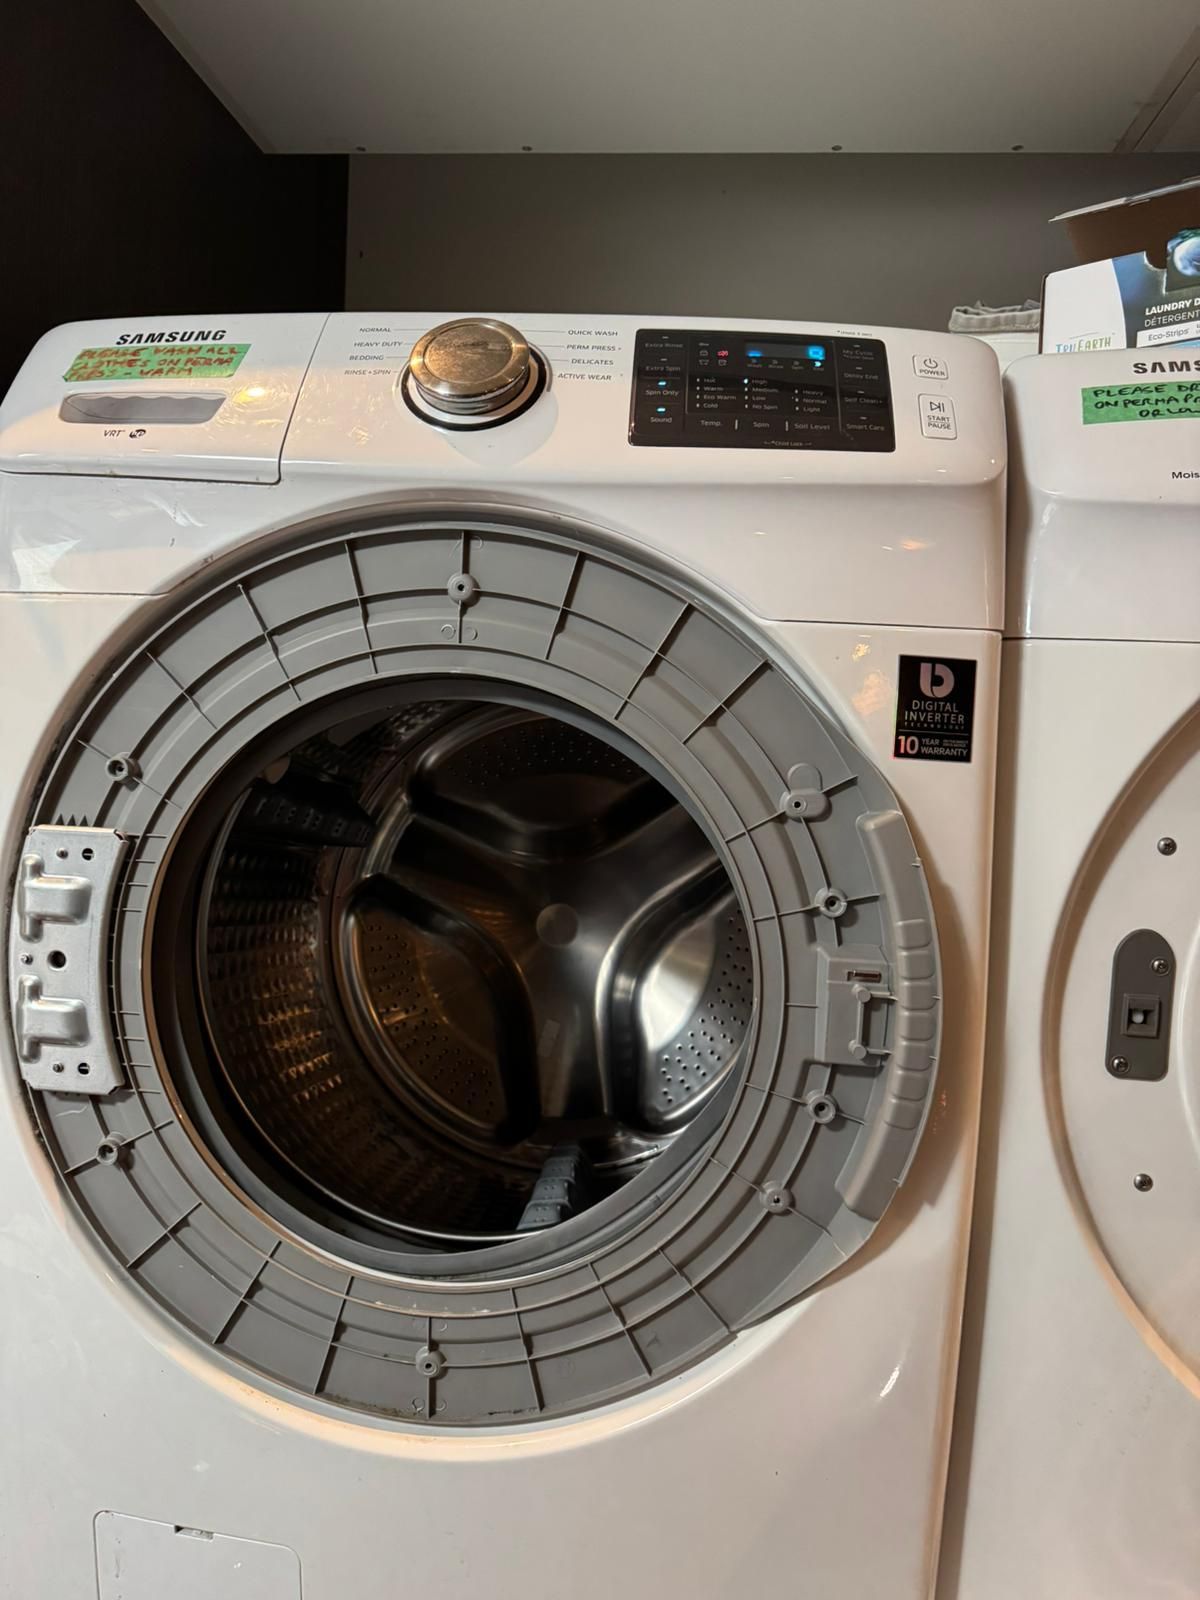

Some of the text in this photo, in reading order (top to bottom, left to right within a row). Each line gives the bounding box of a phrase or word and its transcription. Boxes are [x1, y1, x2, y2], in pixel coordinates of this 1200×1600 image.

[1145, 299, 1193, 316] LAUNDRY
[1144, 309, 1200, 328] DÉTERGENT
[116, 329, 227, 345] SAMSUNG
[1148, 328, 1189, 341] Eco-Strips
[1093, 384, 1168, 397] PLEASE
[1094, 400, 1119, 409] ON
[1122, 396, 1179, 408] PERMA
[927, 414, 950, 422] START
[1139, 409, 1165, 417] OR
[927, 422, 951, 430] PAUSE
[912, 700, 959, 712] DIGITAL
[905, 711, 965, 724] INVERTER
[898, 735, 919, 755] 10
[921, 746, 968, 756] WARRANTY
